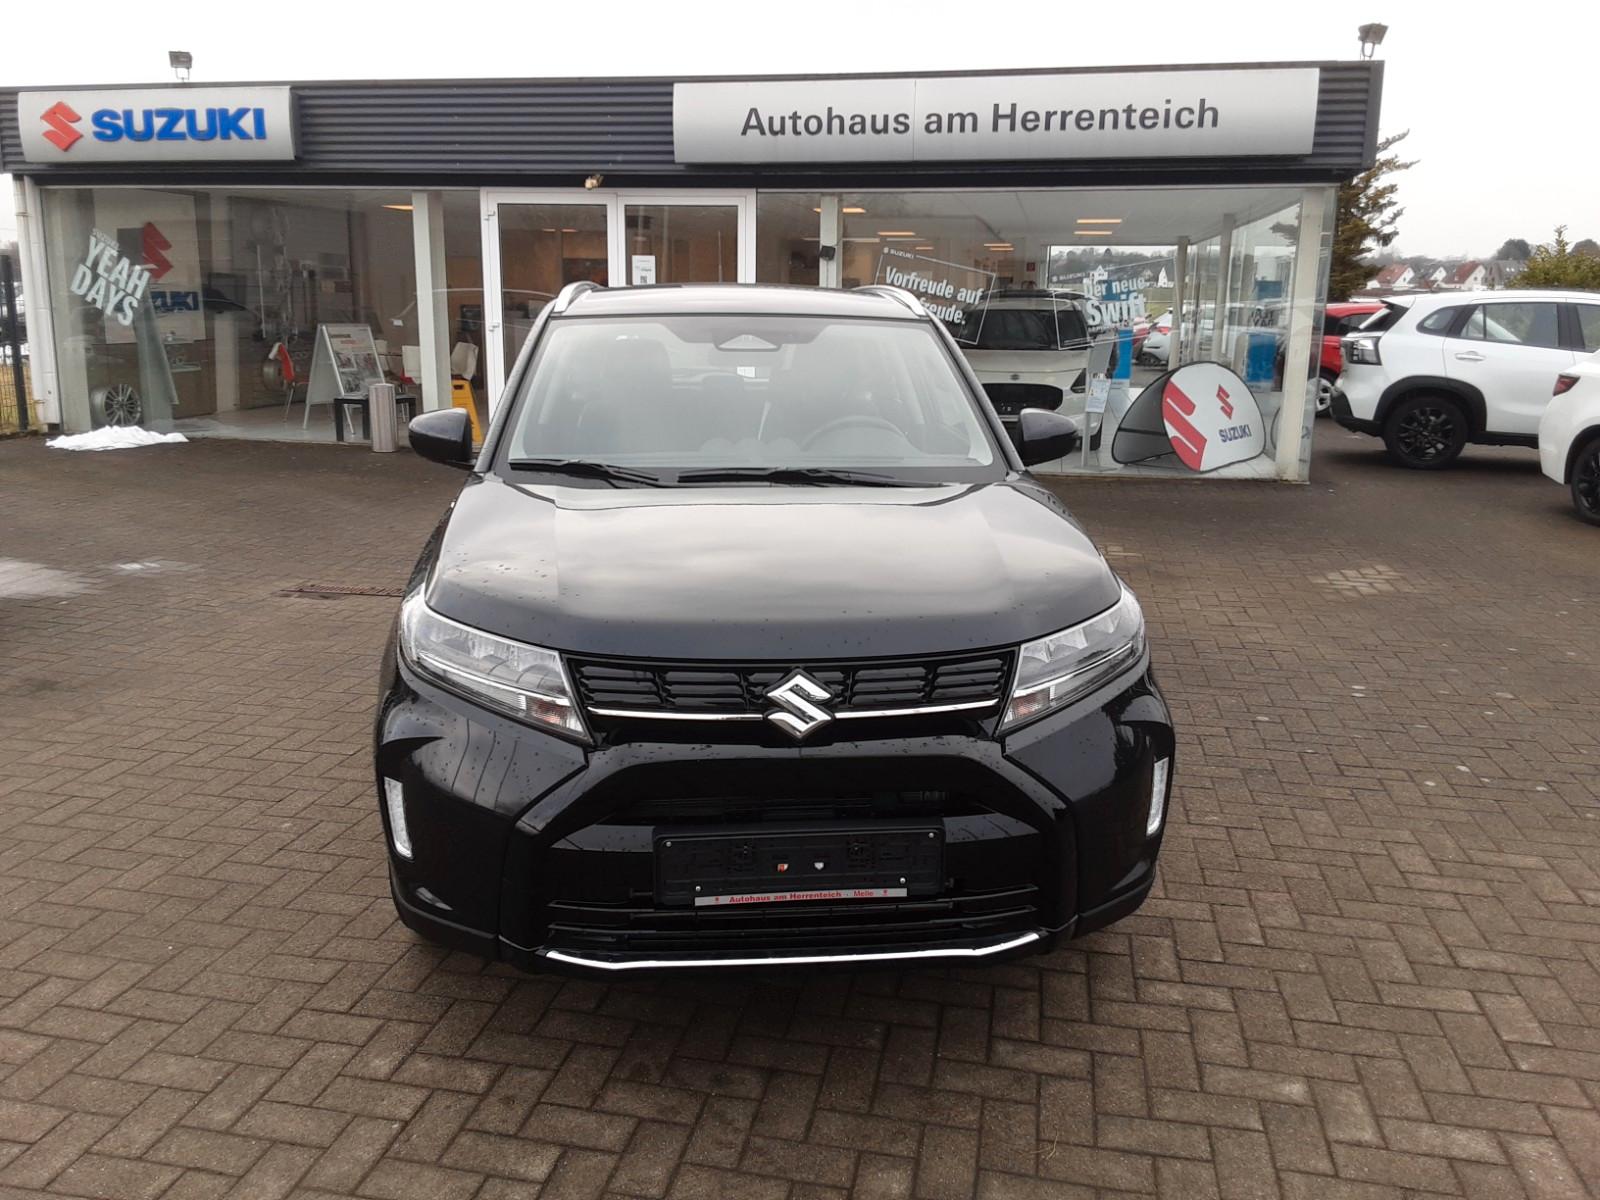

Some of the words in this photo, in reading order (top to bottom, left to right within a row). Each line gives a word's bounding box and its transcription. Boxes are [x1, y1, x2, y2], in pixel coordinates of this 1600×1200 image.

[91, 107, 267, 142] SUZUKI
[741, 107, 910, 136] Autohaus
[924, 110, 979, 134] am
[992, 98, 1219, 132] Herrenteich
[85, 234, 151, 299] YEAH
[70, 263, 139, 326] DAYS
[885, 266, 954, 298] Vorfreude
[957, 287, 985, 305] auf
[1083, 278, 1108, 298] Der
[1112, 277, 1146, 291] neue
[1086, 291, 1147, 326] Swift
[1218, 424, 1252, 443] SUZUKI
[729, 895, 771, 904] Autohaus
[790, 890, 842, 899] Herrenteich
